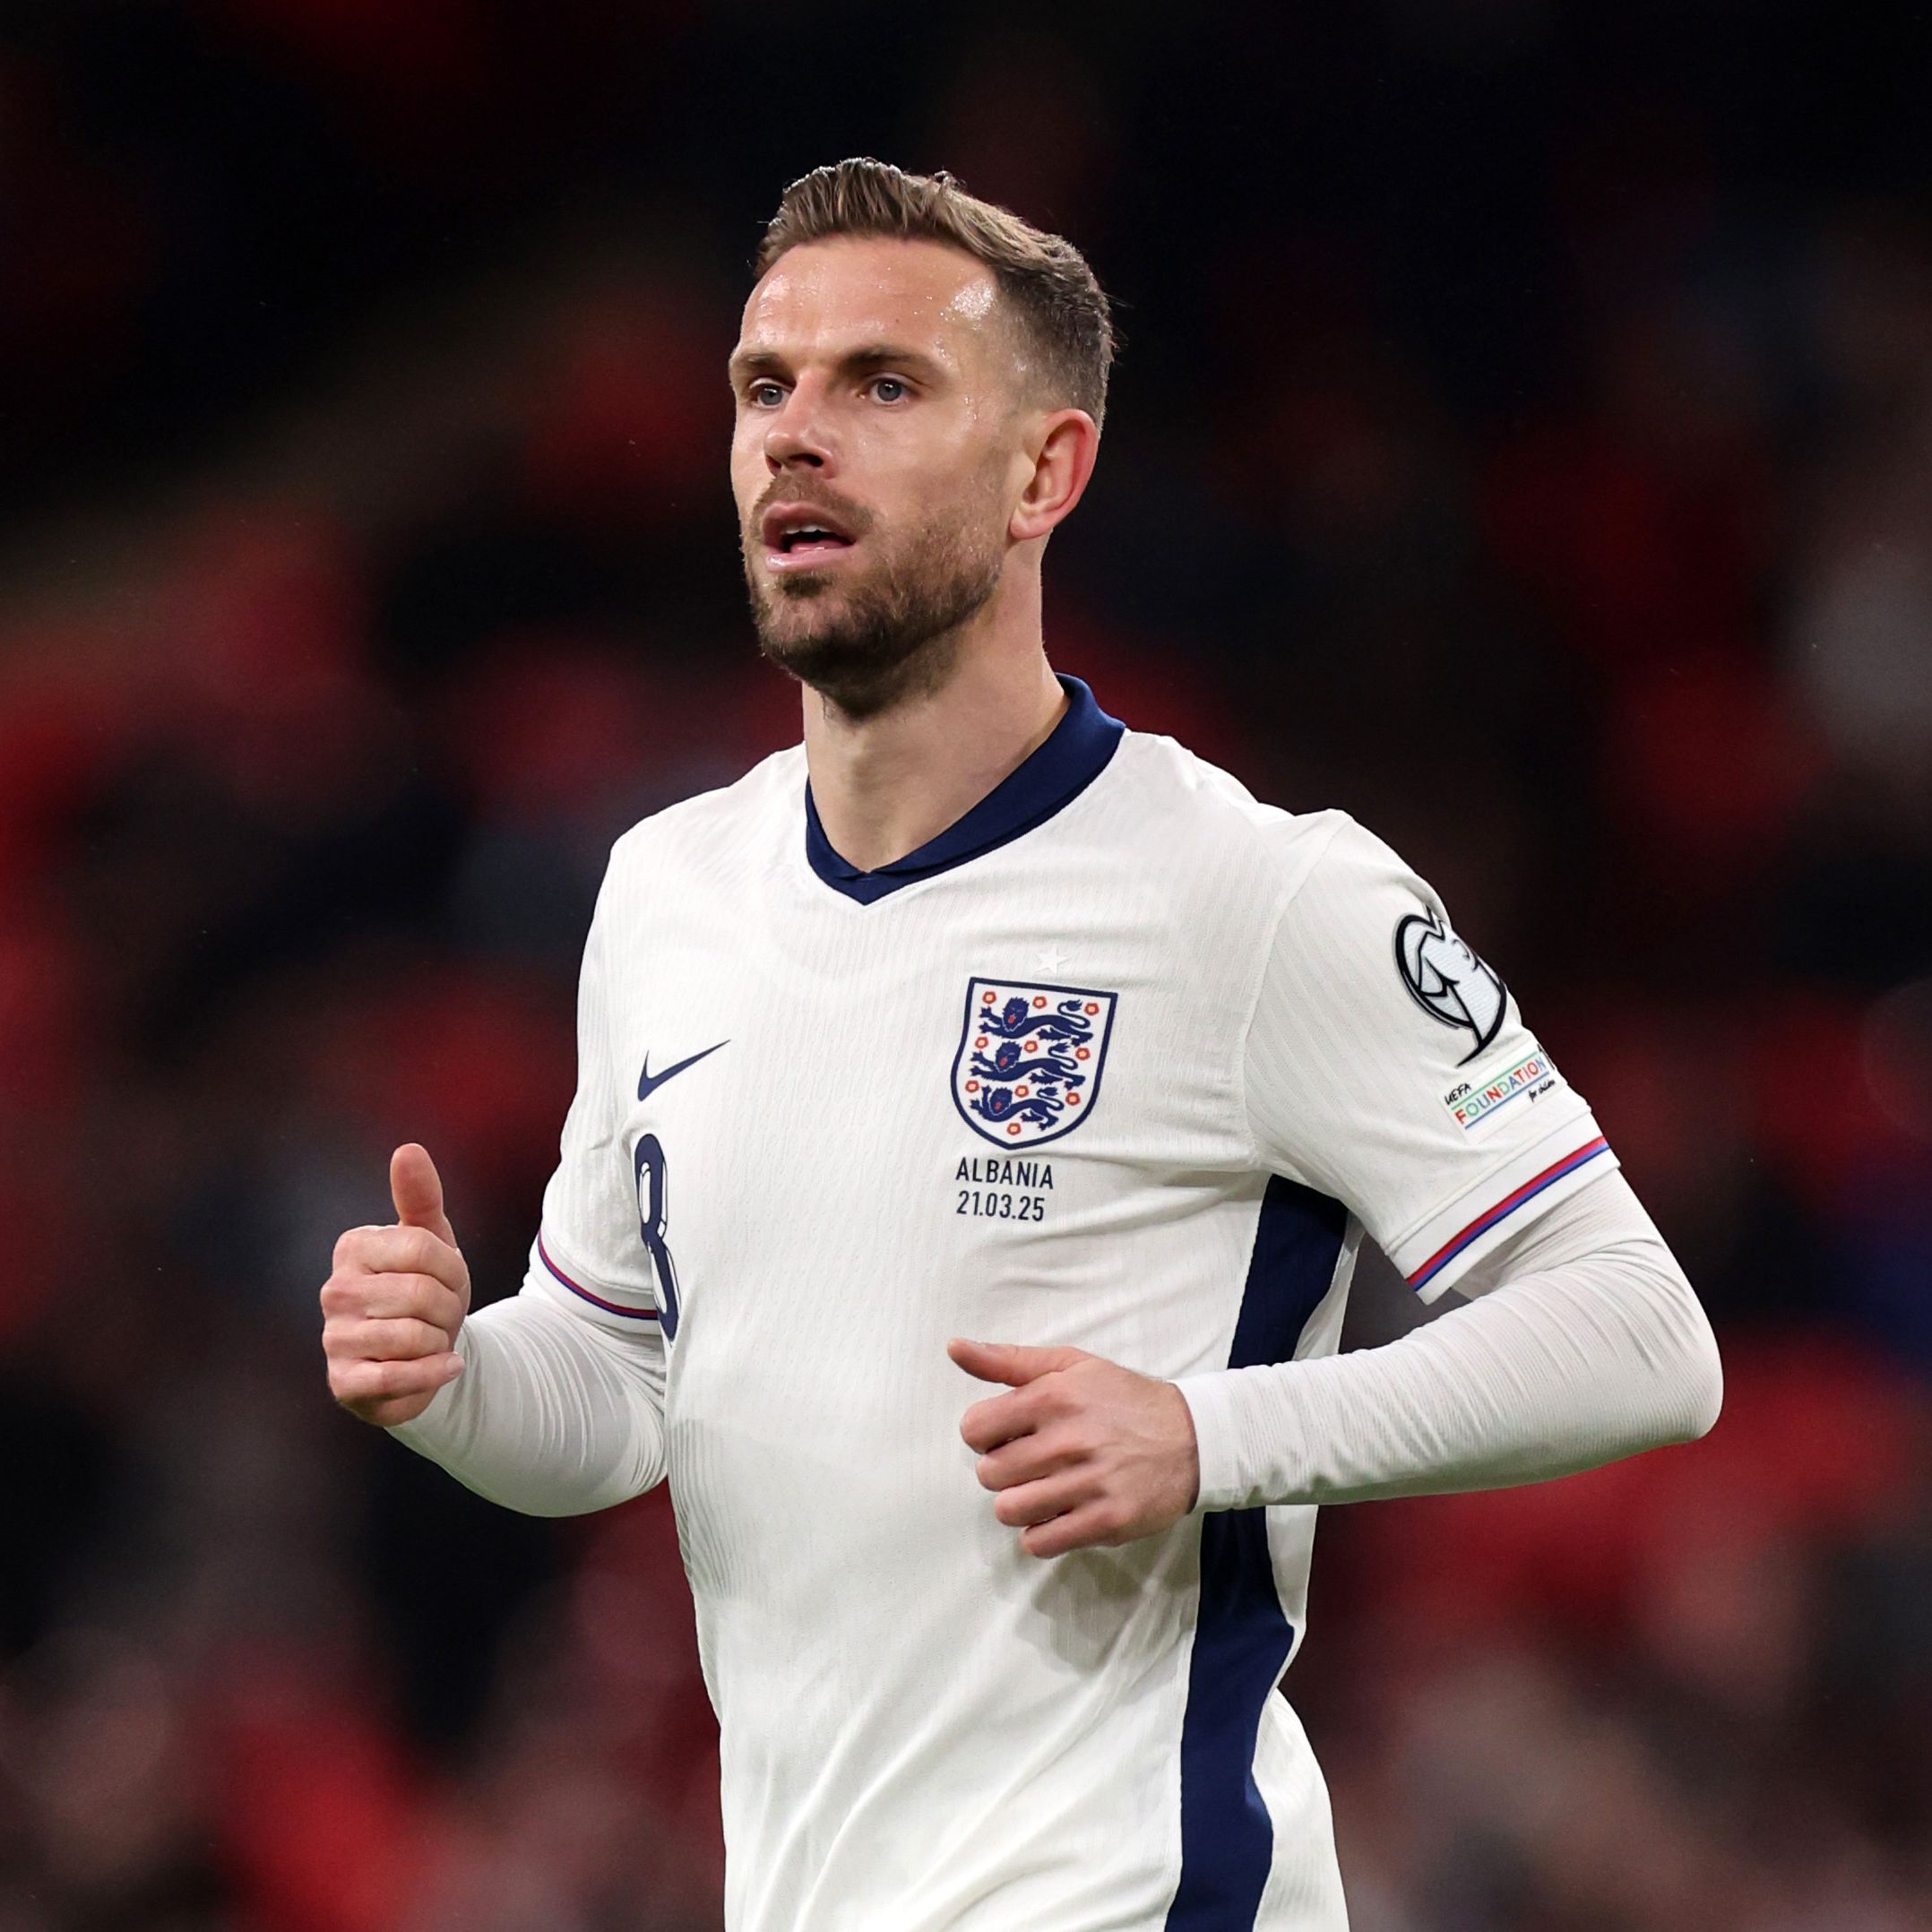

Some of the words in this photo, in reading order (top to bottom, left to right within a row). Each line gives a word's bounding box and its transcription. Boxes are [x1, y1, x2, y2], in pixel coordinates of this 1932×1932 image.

[1444, 1082, 1471, 1105] UEFA
[1454, 1057, 1547, 1125] FOUNDATION
[955, 1156, 1054, 1190] ALBANIA
[956, 1190, 1045, 1221] 21.03.25
